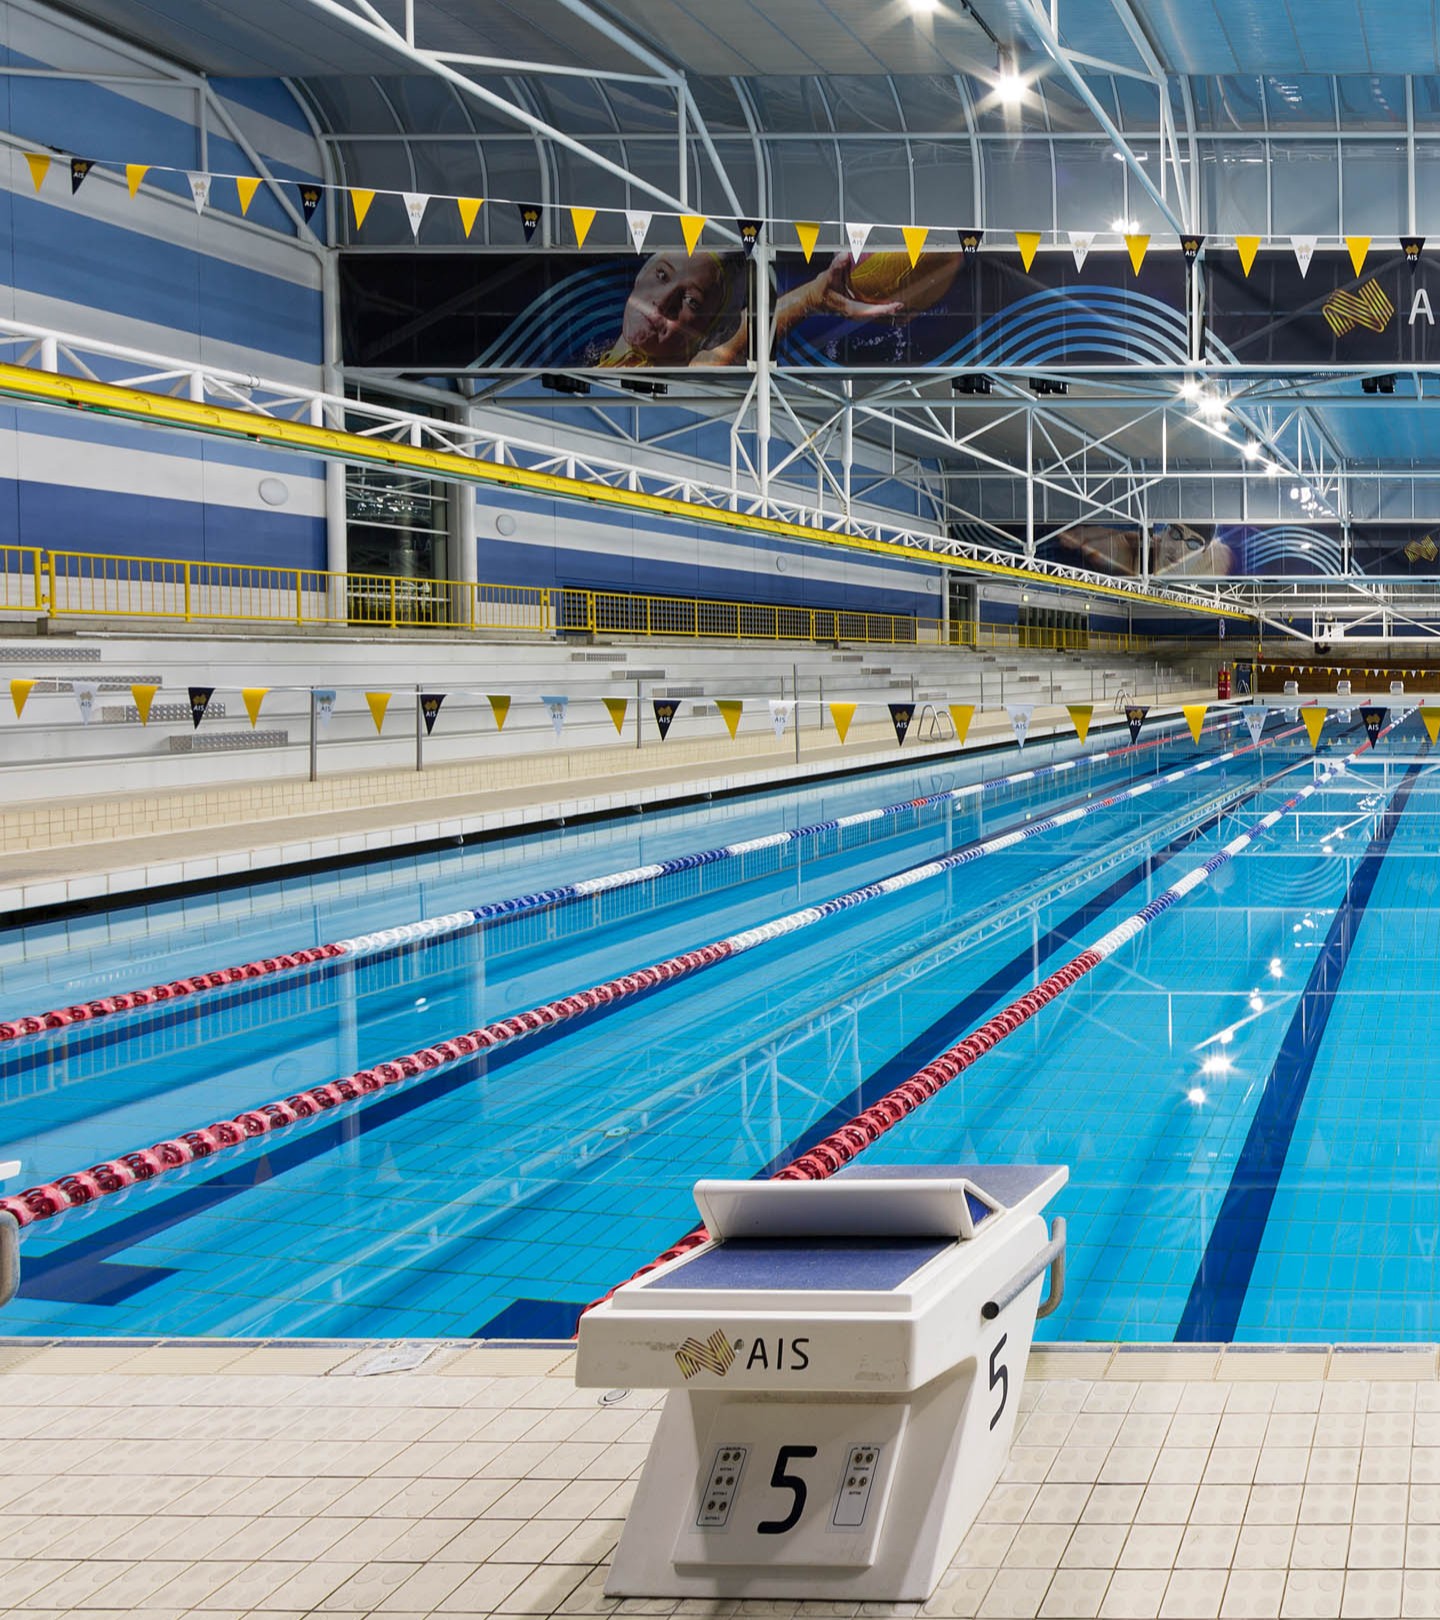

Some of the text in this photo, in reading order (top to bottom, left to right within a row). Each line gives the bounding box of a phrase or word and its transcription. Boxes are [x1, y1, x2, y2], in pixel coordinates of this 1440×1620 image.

[746, 1338, 809, 1370] AIS
[989, 1333, 1008, 1431] 5
[757, 1445, 817, 1534] 5
